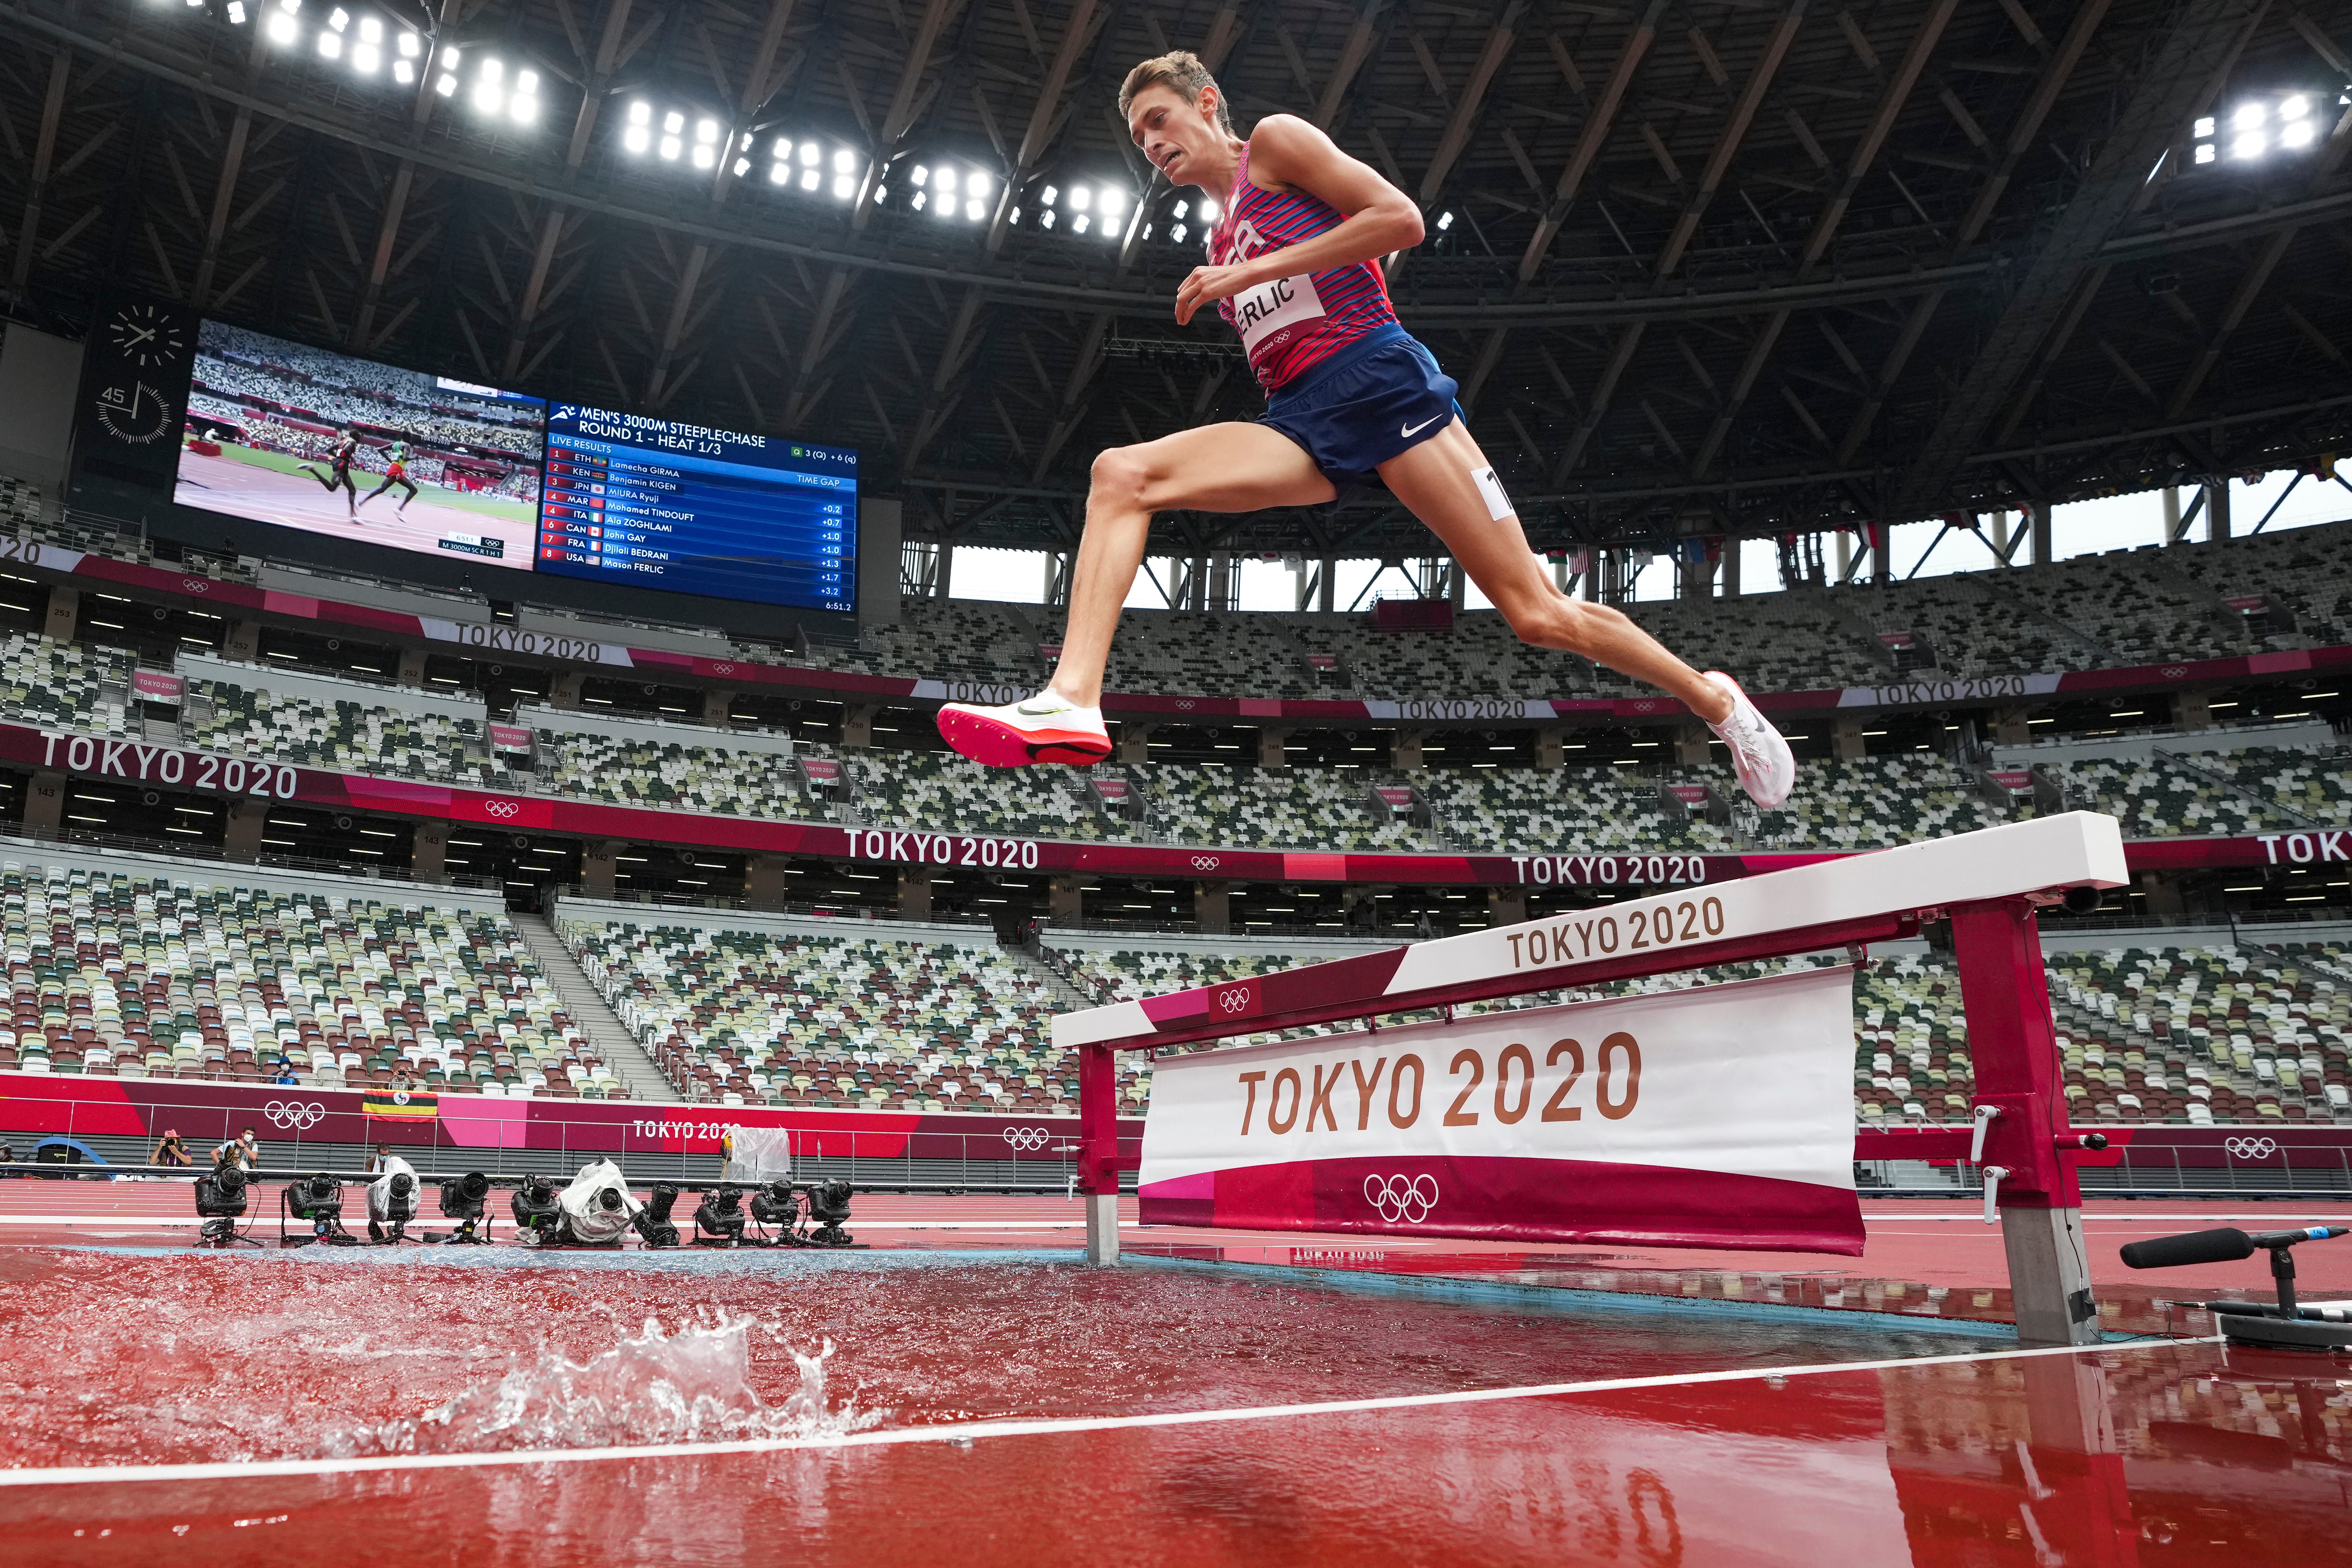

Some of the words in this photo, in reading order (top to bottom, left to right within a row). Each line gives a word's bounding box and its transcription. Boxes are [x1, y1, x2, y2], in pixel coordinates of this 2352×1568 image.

[1251, 350, 1262, 363] TOKYO
[1262, 341, 1274, 353] 2020
[102, 387, 125, 403] 45
[205, 382, 224, 392] TOKYO
[225, 388, 239, 397] 2020
[579, 420, 631, 440] ROUND
[636, 431, 643, 443] 1
[658, 435, 695, 450] HEAT
[698, 441, 721, 455] 1/3
[580, 407, 620, 424] MEN'S
[624, 414, 667, 432] 3000M
[670, 422, 765, 448] STEEPLECHASE
[552, 436, 571, 446] LIVE
[574, 440, 611, 453] RESULTS
[575, 453, 591, 463] ETH
[611, 460, 647, 473] Lamecha
[650, 466, 679, 478] GIRMA
[813, 451, 826, 460] (Q)
[845, 455, 856, 464] (q)
[573, 468, 590, 477] KEN
[610, 474, 647, 486] Benjamin
[650, 480, 676, 490] KIGEN
[797, 475, 818, 485] TIME
[821, 478, 840, 487] GAP
[574, 482, 589, 490] JPN
[609, 488, 637, 499] MIURA
[640, 493, 659, 504] Ryuji
[1486, 471, 1513, 510] 1
[567, 495, 588, 505] MAR
[608, 502, 649, 515] Mohamed
[651, 508, 694, 521] TINDOUFT
[574, 510, 587, 519] ITA
[624, 518, 672, 532] ZOGHLAMI
[566, 524, 586, 533] CAN
[606, 530, 625, 540] John
[627, 533, 646, 543] GAY
[450, 543, 470, 552] 3000M
[568, 538, 585, 548] FRA
[605, 544, 629, 555] Djilali
[631, 548, 668, 560] BEDRANI
[566, 553, 584, 563] USA
[604, 559, 632, 569] Mason
[634, 563, 663, 574] FERLIC
[826, 602, 851, 611] 6:51.2
[455, 623, 535, 653] TOKYO
[543, 637, 600, 663] 2020
[140, 679, 160, 687] TOKYO
[942, 682, 1013, 704] TOKYO
[1871, 681, 1955, 706] TOKYO
[1962, 676, 2025, 699] 2020
[1395, 700, 1467, 719] TOKYO
[1472, 700, 1526, 718] 2020
[40, 731, 185, 784] TOKYO
[195, 755, 297, 799] 2020
[37, 788, 55, 797] 143
[844, 828, 951, 864] TOKYO
[961, 836, 1038, 869] 2020
[2257, 831, 2352, 865] TOK
[1512, 856, 1617, 884] TOKYO
[1627, 855, 1705, 884] 2020
[1506, 918, 1619, 968] TOKYO
[1630, 896, 1724, 950] 2020
[1239, 1054, 1425, 1136] TOKYO
[1443, 1031, 1642, 1127] 2020
[633, 1120, 694, 1138] TOKYO
